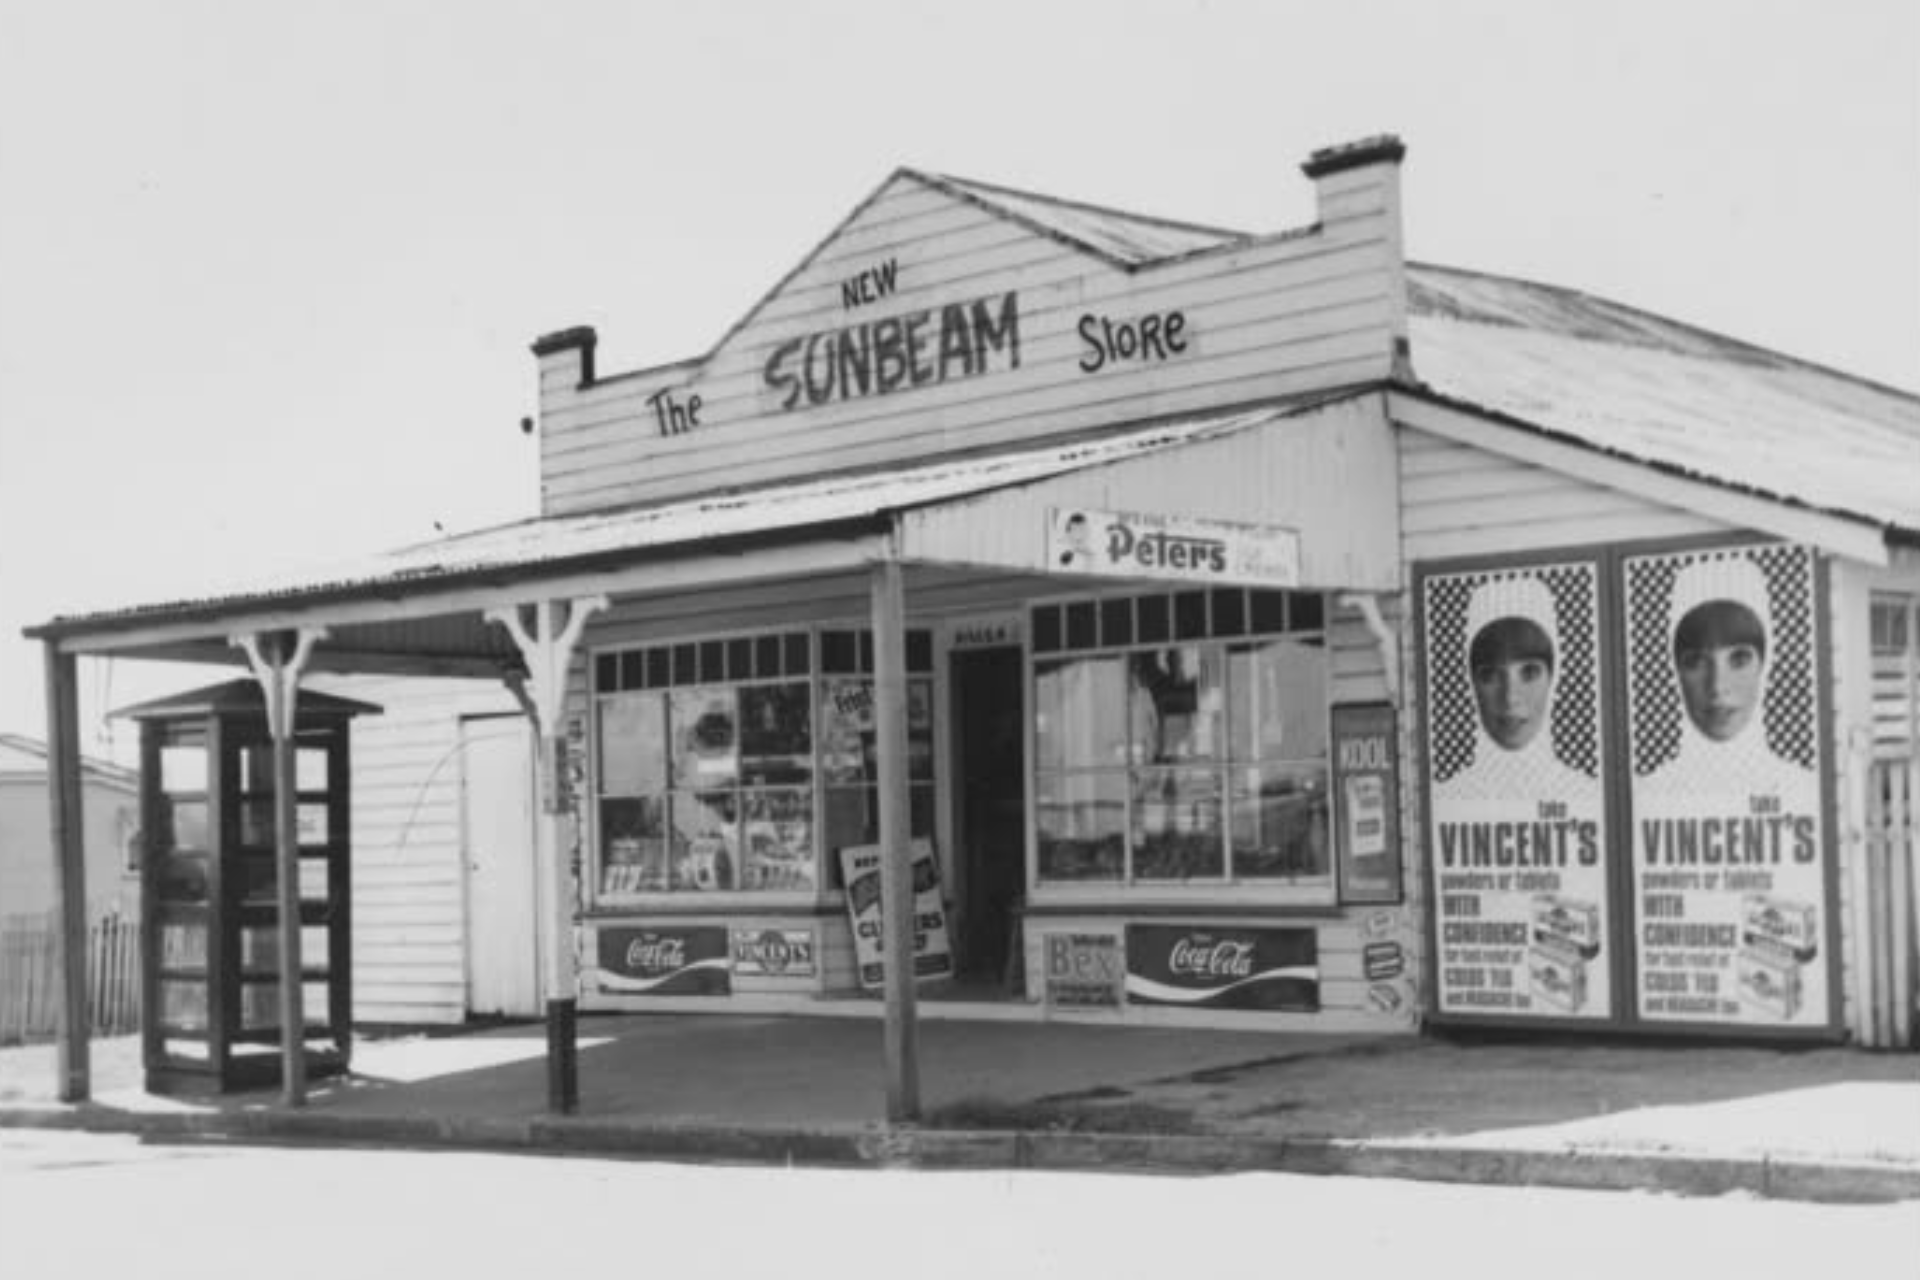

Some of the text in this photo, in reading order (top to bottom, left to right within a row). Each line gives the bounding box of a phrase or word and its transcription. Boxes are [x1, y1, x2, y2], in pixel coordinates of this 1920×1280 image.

[841, 258, 897, 309] NEW
[646, 386, 702, 436] The
[763, 291, 1019, 411] SUNBEAM
[1105, 522, 1226, 573] Peters
[1439, 817, 1598, 868] VINCENT'S
[1641, 813, 1815, 865] VINCENT'S
[1050, 934, 1113, 979] Bex
[1444, 922, 1528, 945] CONFIDENCE
[1643, 923, 1737, 947] CONFIDENCE
